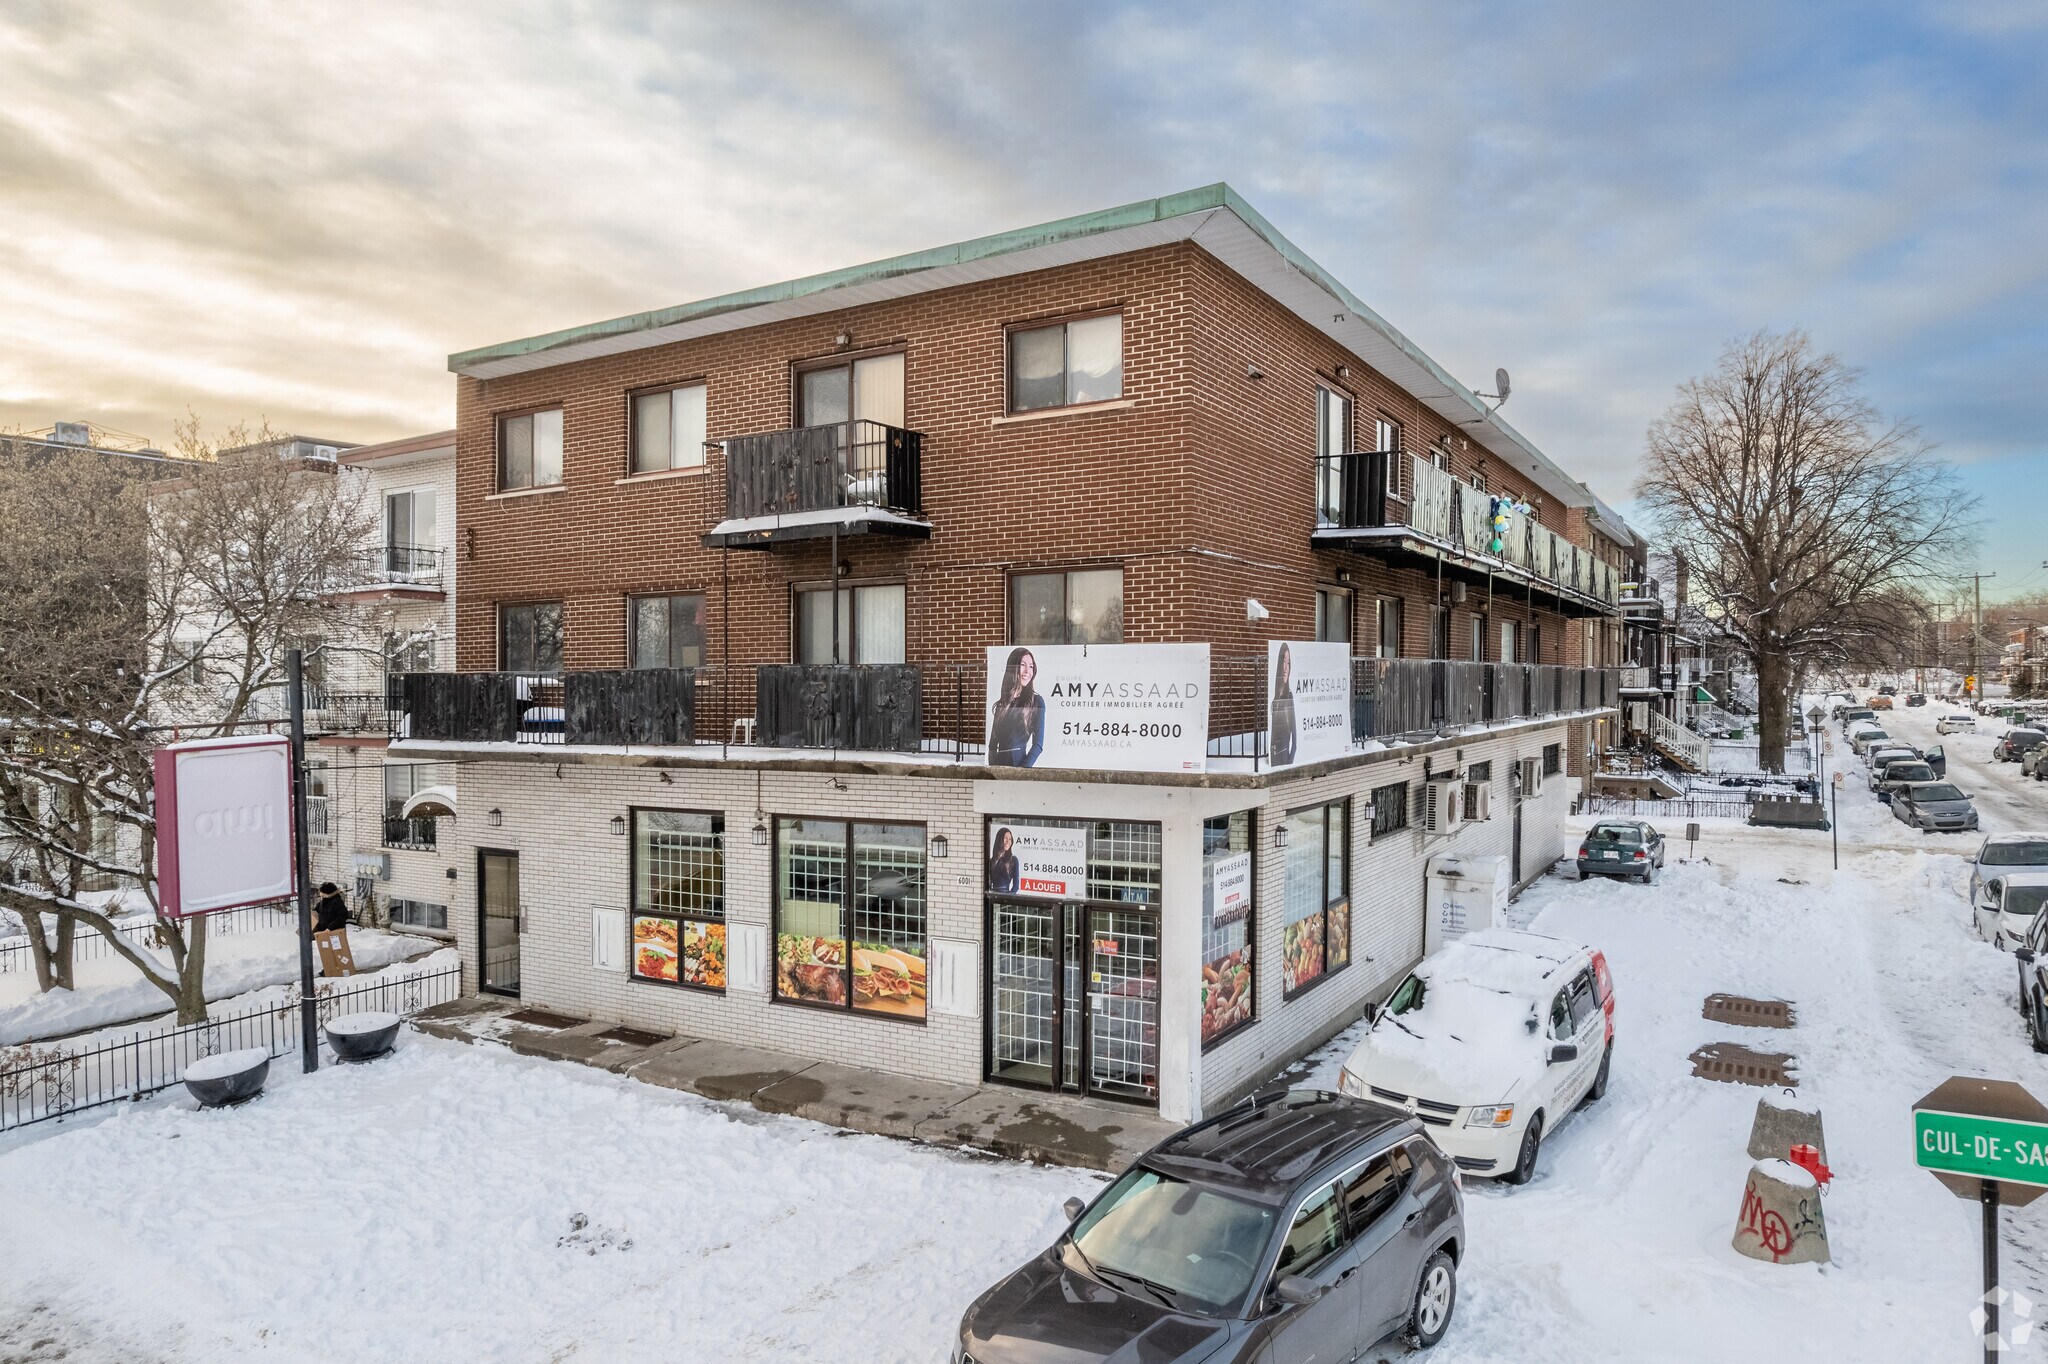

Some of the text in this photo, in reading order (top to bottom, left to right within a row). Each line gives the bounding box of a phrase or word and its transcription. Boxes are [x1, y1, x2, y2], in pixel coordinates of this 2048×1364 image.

[1060, 700, 1184, 709] COURTIER IMMOBILIER AGRÉÉ
[1303, 714, 1343, 731] 514-884-8000
[1062, 722, 1182, 738] 514-884-8000
[1061, 739, 1132, 749] AMYASSAAD.CA
[1023, 863, 1084, 876] 514.884.8000
[1024, 879, 1062, 893] À LOUER
[1923, 1128, 2048, 1167] CUL-DE-SA
